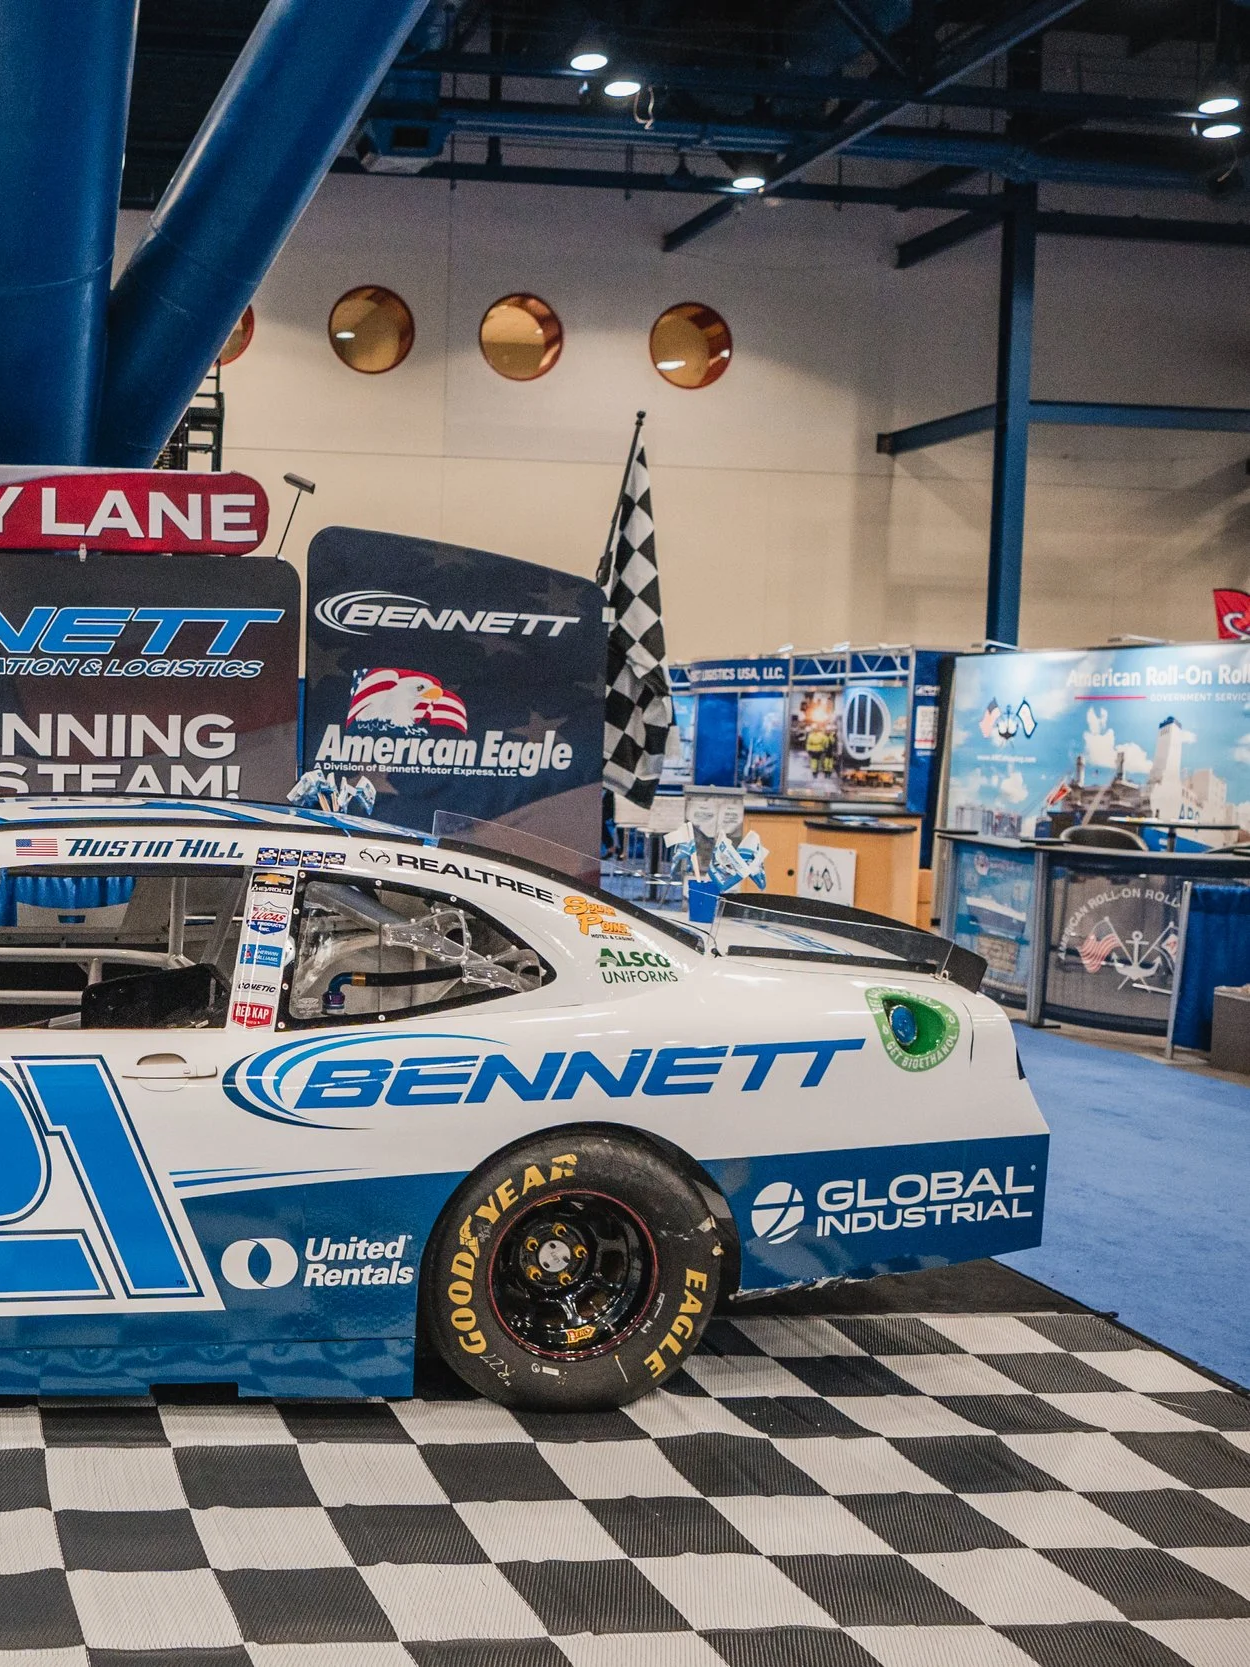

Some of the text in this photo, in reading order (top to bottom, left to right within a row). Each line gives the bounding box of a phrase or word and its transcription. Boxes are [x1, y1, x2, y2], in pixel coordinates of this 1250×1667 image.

[41, 487, 258, 543] LANE
[341, 603, 580, 637] BENNETT
[83, 658, 102, 678] &
[104, 657, 265, 679] LOGISTICS
[737, 667, 761, 681] USA,
[763, 667, 786, 680] LLC.
[1066, 667, 1141, 687] American
[1146, 664, 1213, 686] Roll-On
[1150, 692, 1213, 702] GOVERNMENT
[314, 724, 573, 777] American Eagle
[38, 764, 242, 799] TEAM!
[314, 762, 517, 777] A Division of Bennett Motor Express, LLC
[65, 838, 175, 858] AUSTIN
[173, 839, 245, 859] HILL
[396, 853, 554, 904] REALTREE
[251, 911, 286, 922] LUCAS
[595, 948, 671, 968] ALSCO
[602, 970, 679, 984] UNIFORMS
[235, 1004, 270, 1020] RED KAP
[886, 1034, 958, 1069] GET BIOETHANOL
[294, 1038, 866, 1110] BENNETT
[816, 1165, 1035, 1212] GLOBAL
[816, 1198, 1033, 1238] INDUSTRIAL
[304, 1234, 407, 1262] United
[303, 1261, 415, 1287] Rentals
[643, 1268, 708, 1379] EAGLE
